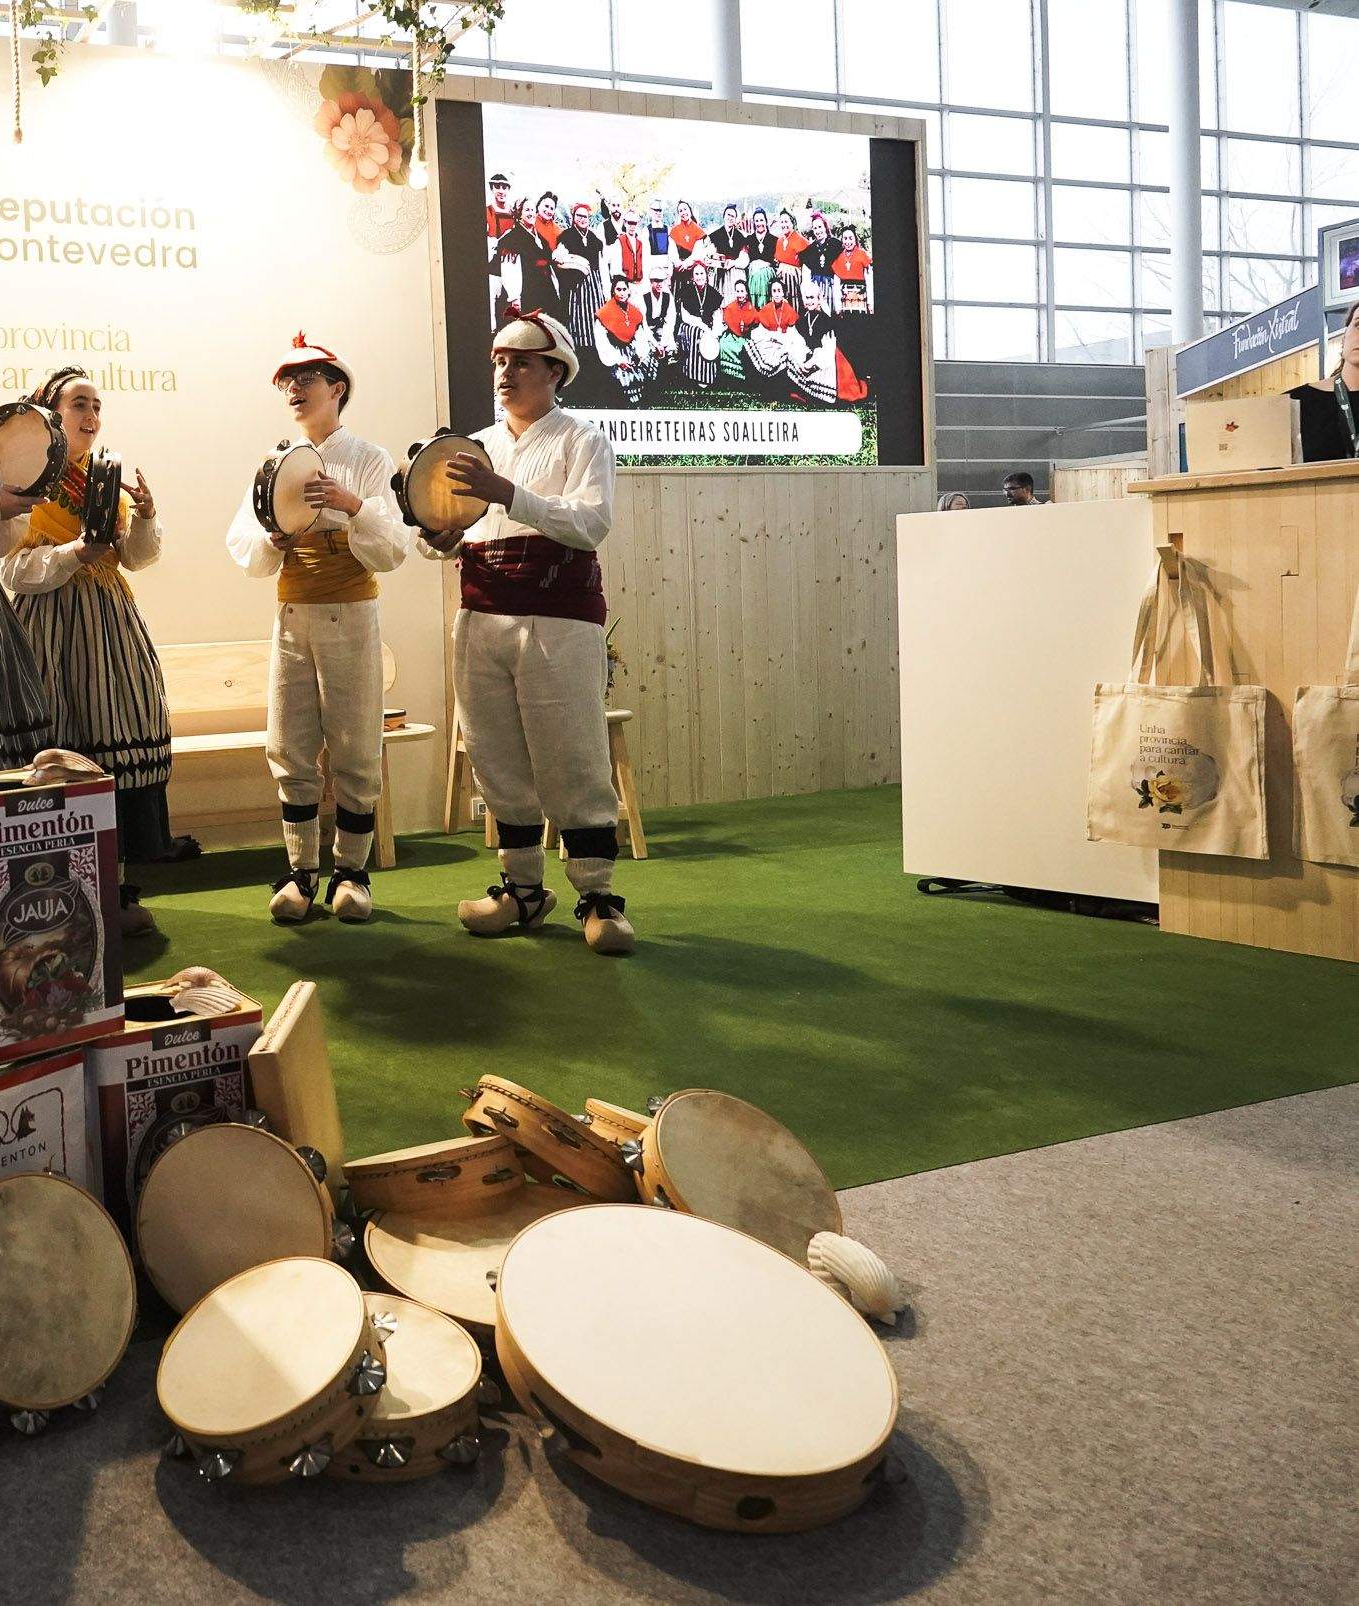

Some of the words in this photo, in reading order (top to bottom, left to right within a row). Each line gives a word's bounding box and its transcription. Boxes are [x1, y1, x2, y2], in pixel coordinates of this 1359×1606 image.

[91, 361, 178, 392] ultura
[589, 419, 717, 442] ANDEIRETEIRAS
[723, 421, 799, 442] SOALLEIRA
[1139, 724, 1166, 735] Unha
[1139, 745, 1162, 755] para
[1164, 746, 1199, 756] cantar
[1148, 755, 1187, 765] cultura
[17, 797, 55, 813] Dulce
[1, 841, 42, 857] ESENCIA
[45, 837, 76, 848] PERLA
[13, 898, 69, 923] JAUJA
[164, 1029, 201, 1047] Dulce
[125, 1041, 241, 1080] Pimentón
[146, 1070, 188, 1089] ESENCIA
[191, 1065, 222, 1079] PERLA
